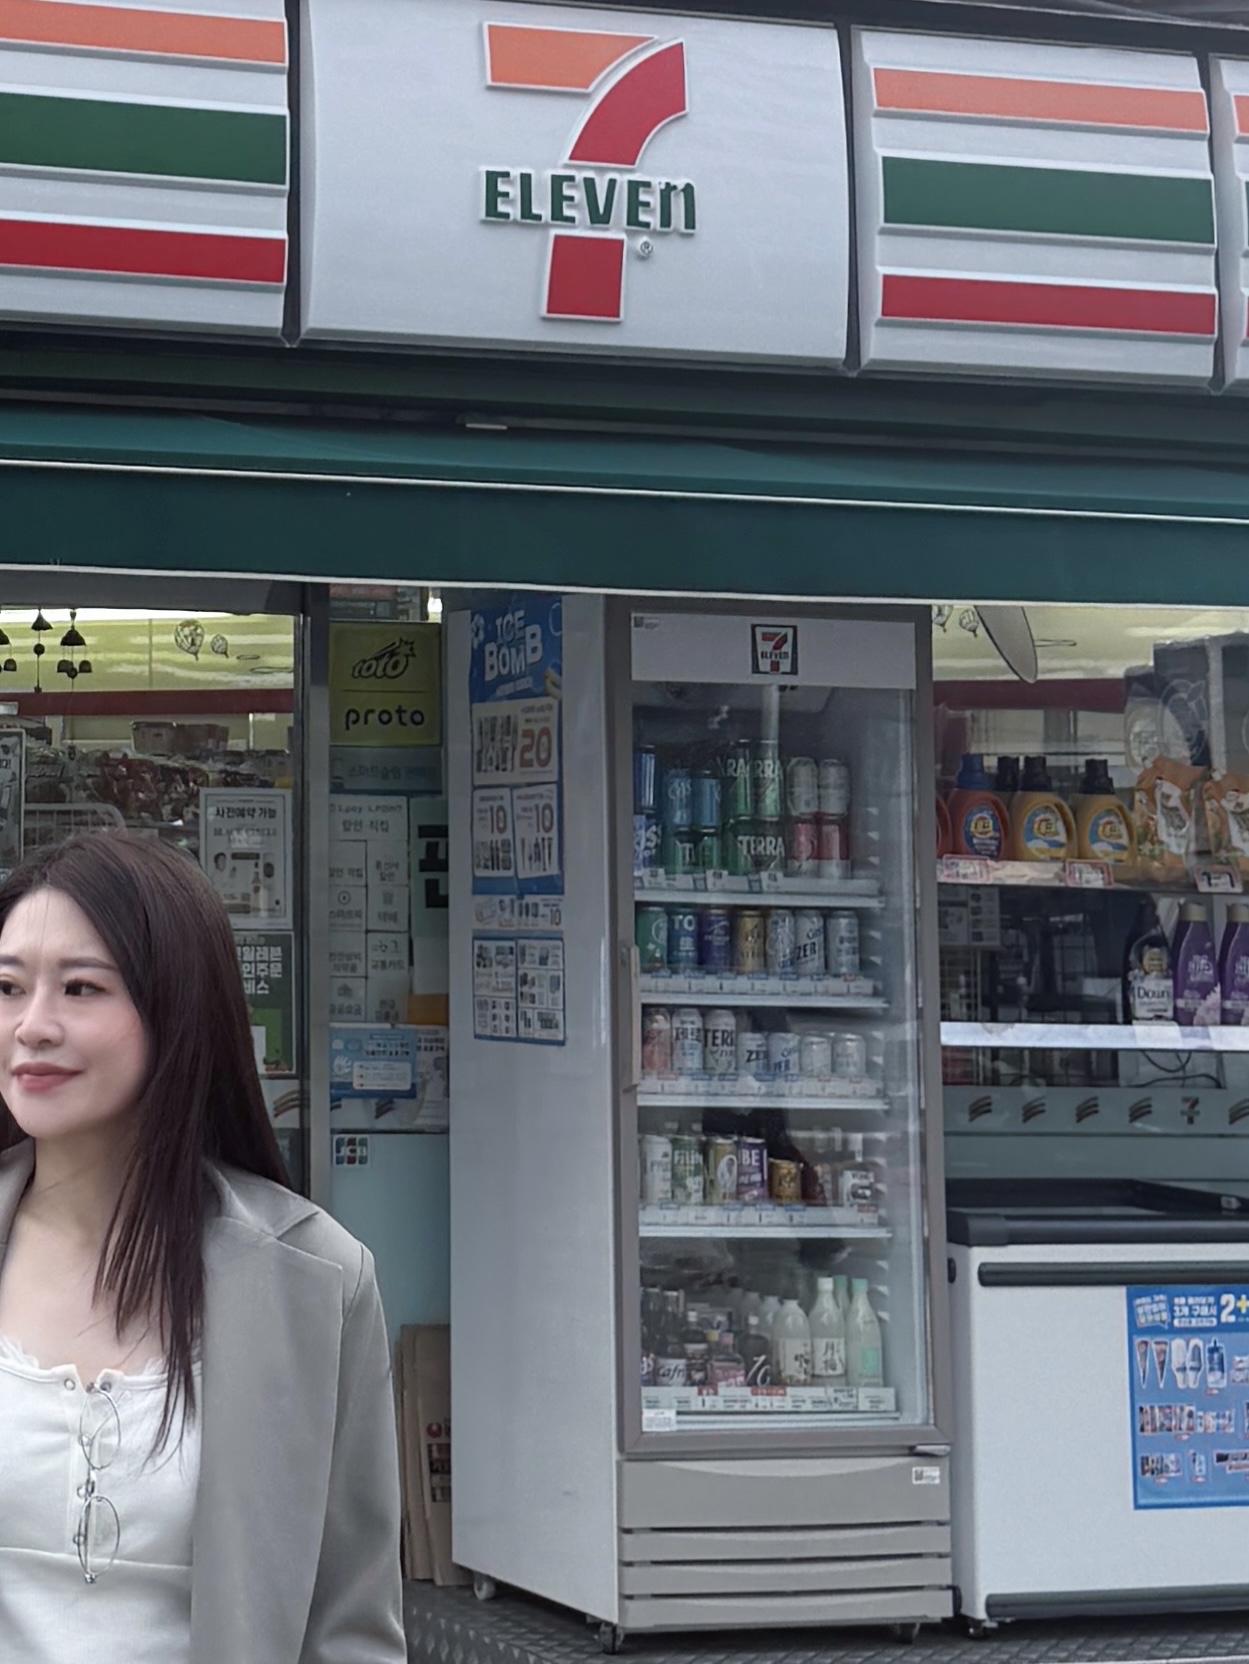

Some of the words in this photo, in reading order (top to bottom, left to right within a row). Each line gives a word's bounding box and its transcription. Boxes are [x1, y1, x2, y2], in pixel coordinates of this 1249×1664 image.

[483, 22, 688, 321] 7
[495, 610, 525, 645] ICE
[484, 624, 543, 682] BOMB
[345, 705, 425, 731] proto
[519, 727, 553, 768] 20
[214, 807, 255, 819] 사전예약
[258, 807, 277, 818] 가능
[237, 946, 283, 961] 일레븐
